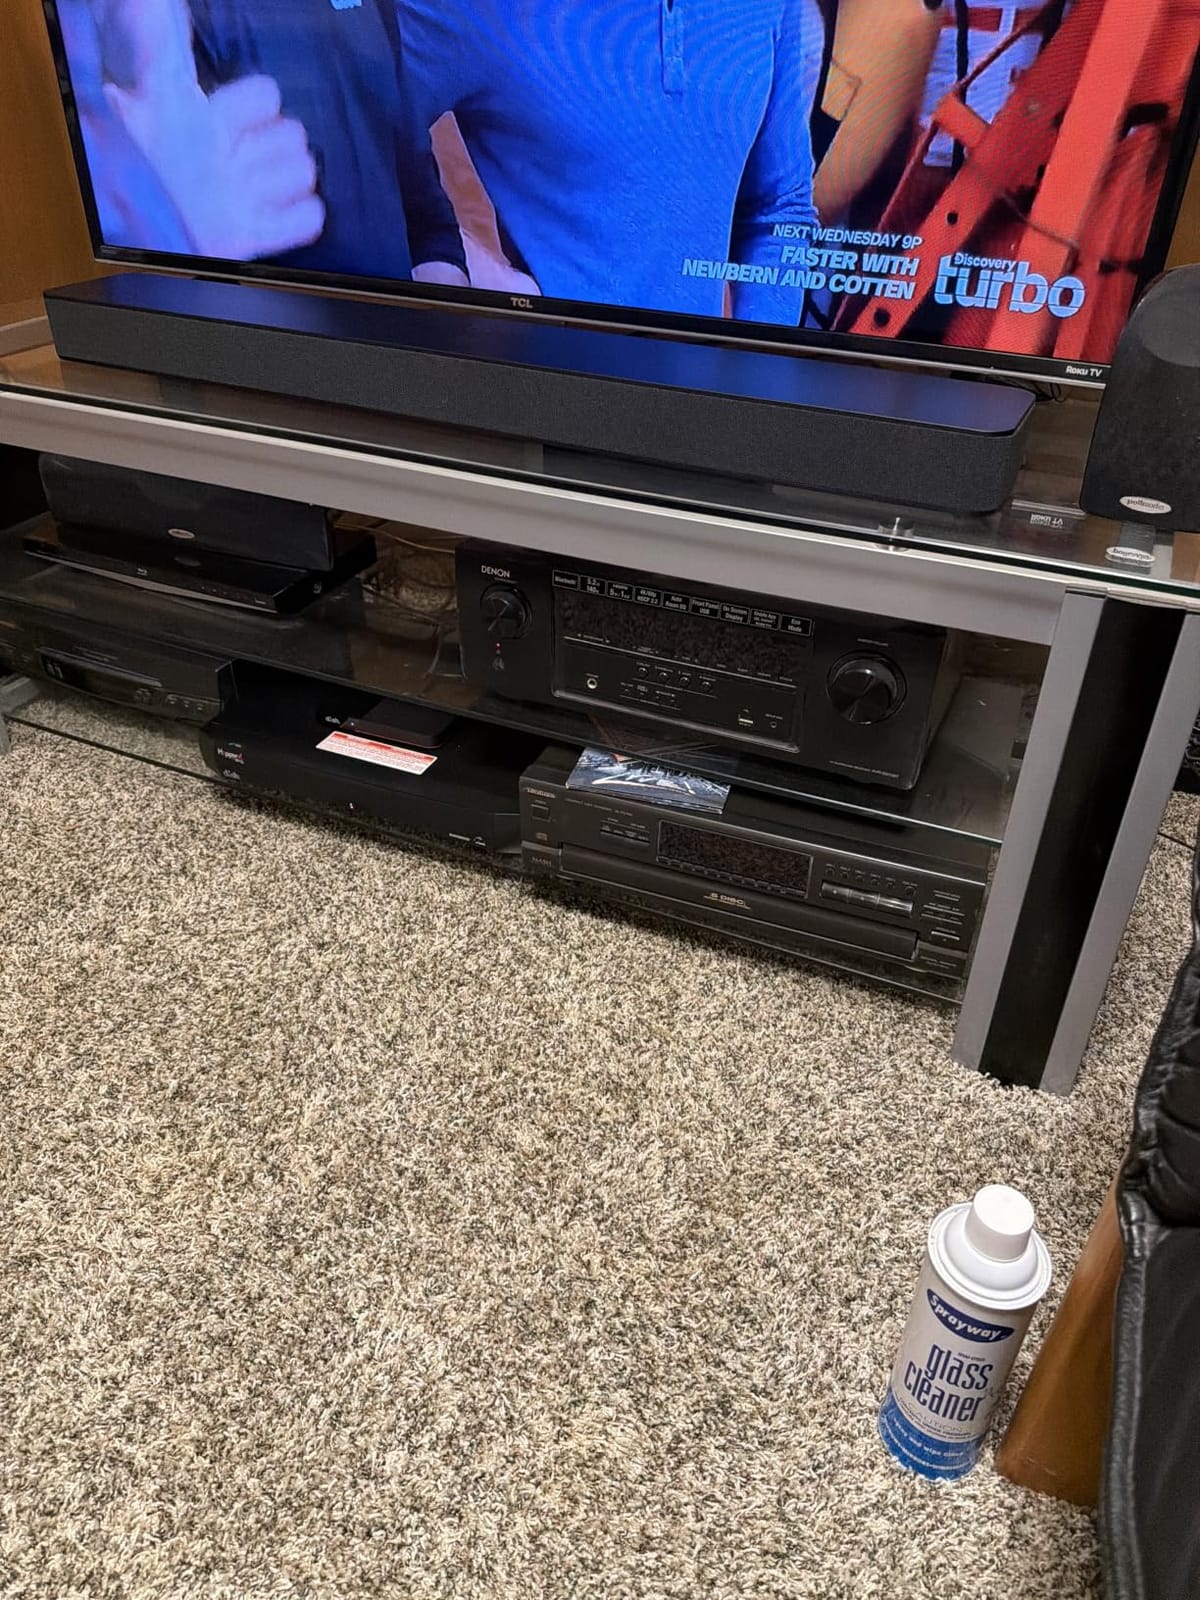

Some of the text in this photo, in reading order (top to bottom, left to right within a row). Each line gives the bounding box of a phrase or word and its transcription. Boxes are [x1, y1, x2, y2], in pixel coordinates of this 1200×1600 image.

[773, 224, 922, 250] NEXT WEDNESDAY 9P
[781, 245, 920, 277] FASTER WITH
[954, 252, 1017, 272] Discovery
[682, 258, 916, 300] NEWBERN AND COTTEN
[934, 255, 1086, 318] turbo
[510, 296, 533, 309] TCL
[1090, 368, 1103, 378] TV
[481, 565, 511, 578] DENON
[930, 1294, 1002, 1341] Sprayway
[925, 1344, 994, 1391] glass
[904, 1361, 985, 1422] cleaner
